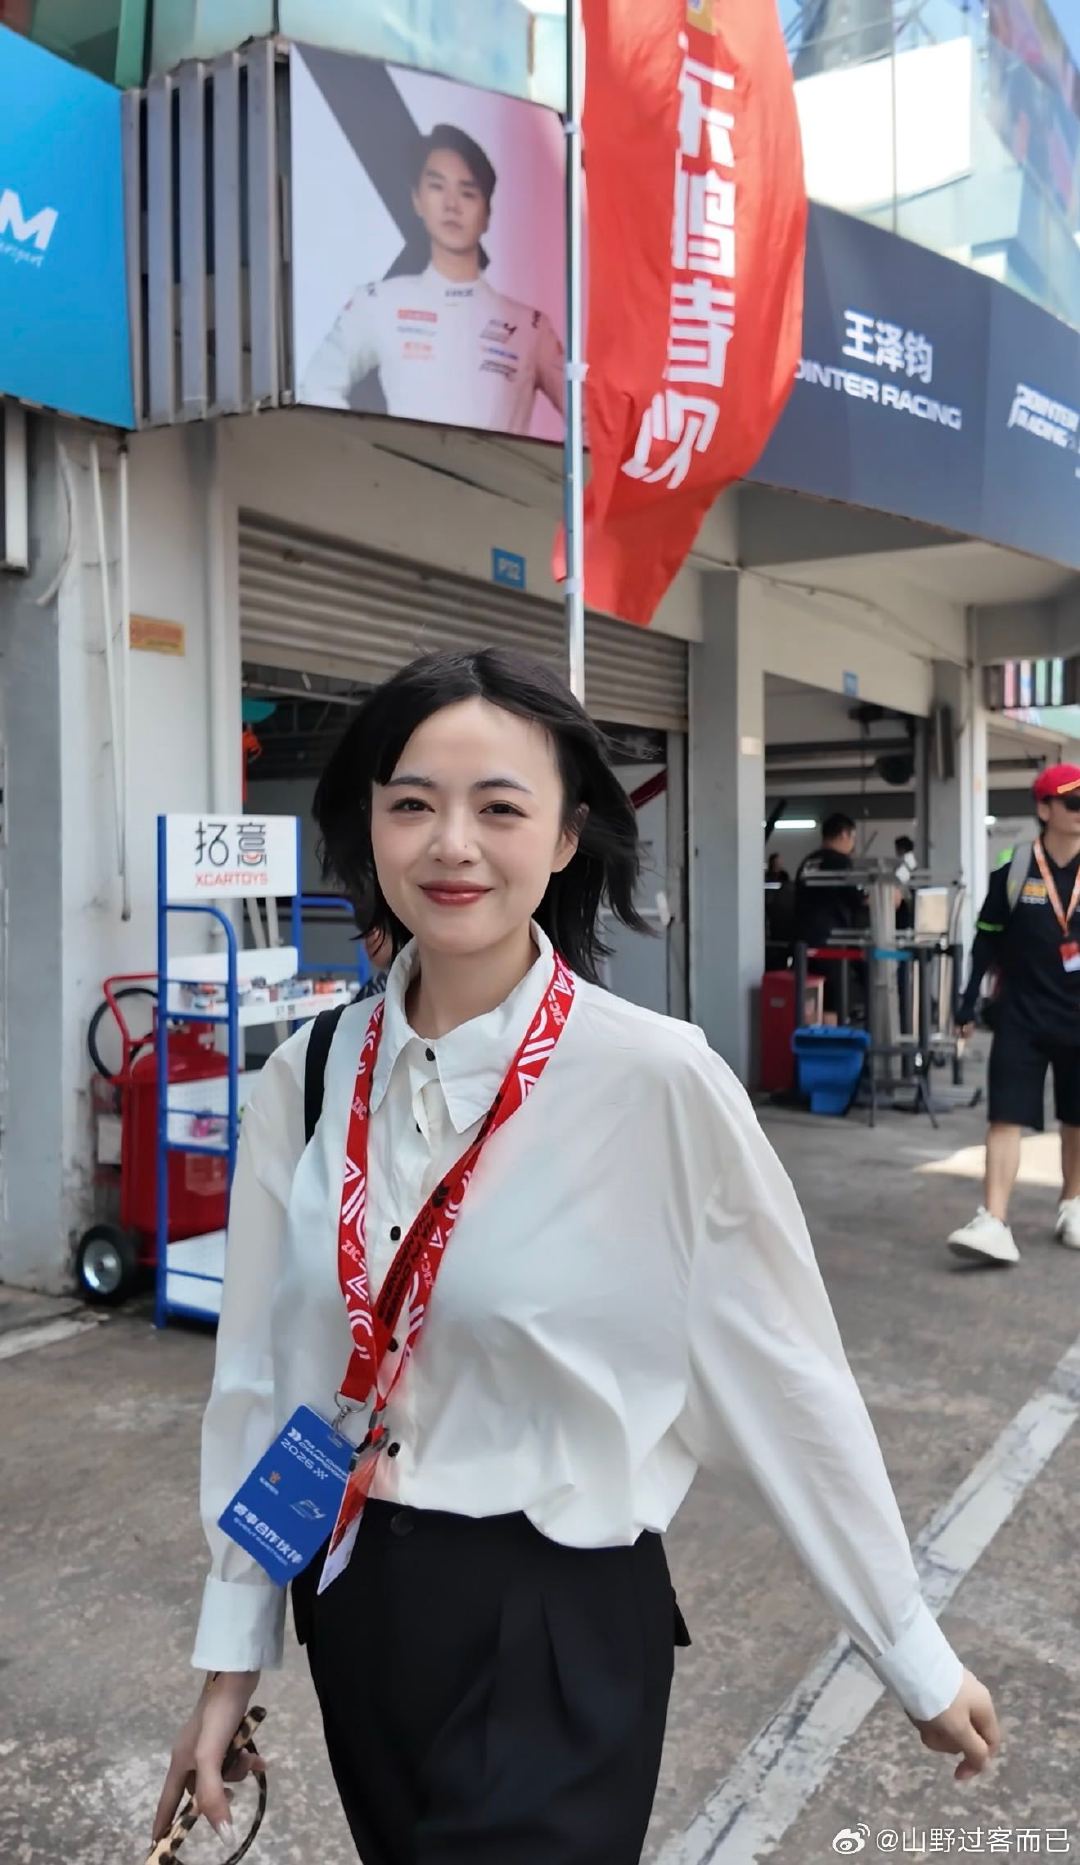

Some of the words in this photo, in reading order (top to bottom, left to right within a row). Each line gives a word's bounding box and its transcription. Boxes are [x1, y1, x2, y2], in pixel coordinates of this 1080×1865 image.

[842, 310, 933, 383] 王泽钧
[881, 383, 962, 430] RACING
[194, 821, 268, 867] 拓意
[194, 871, 269, 887] XCARTOYS
[280, 1438, 315, 1470] 2026
